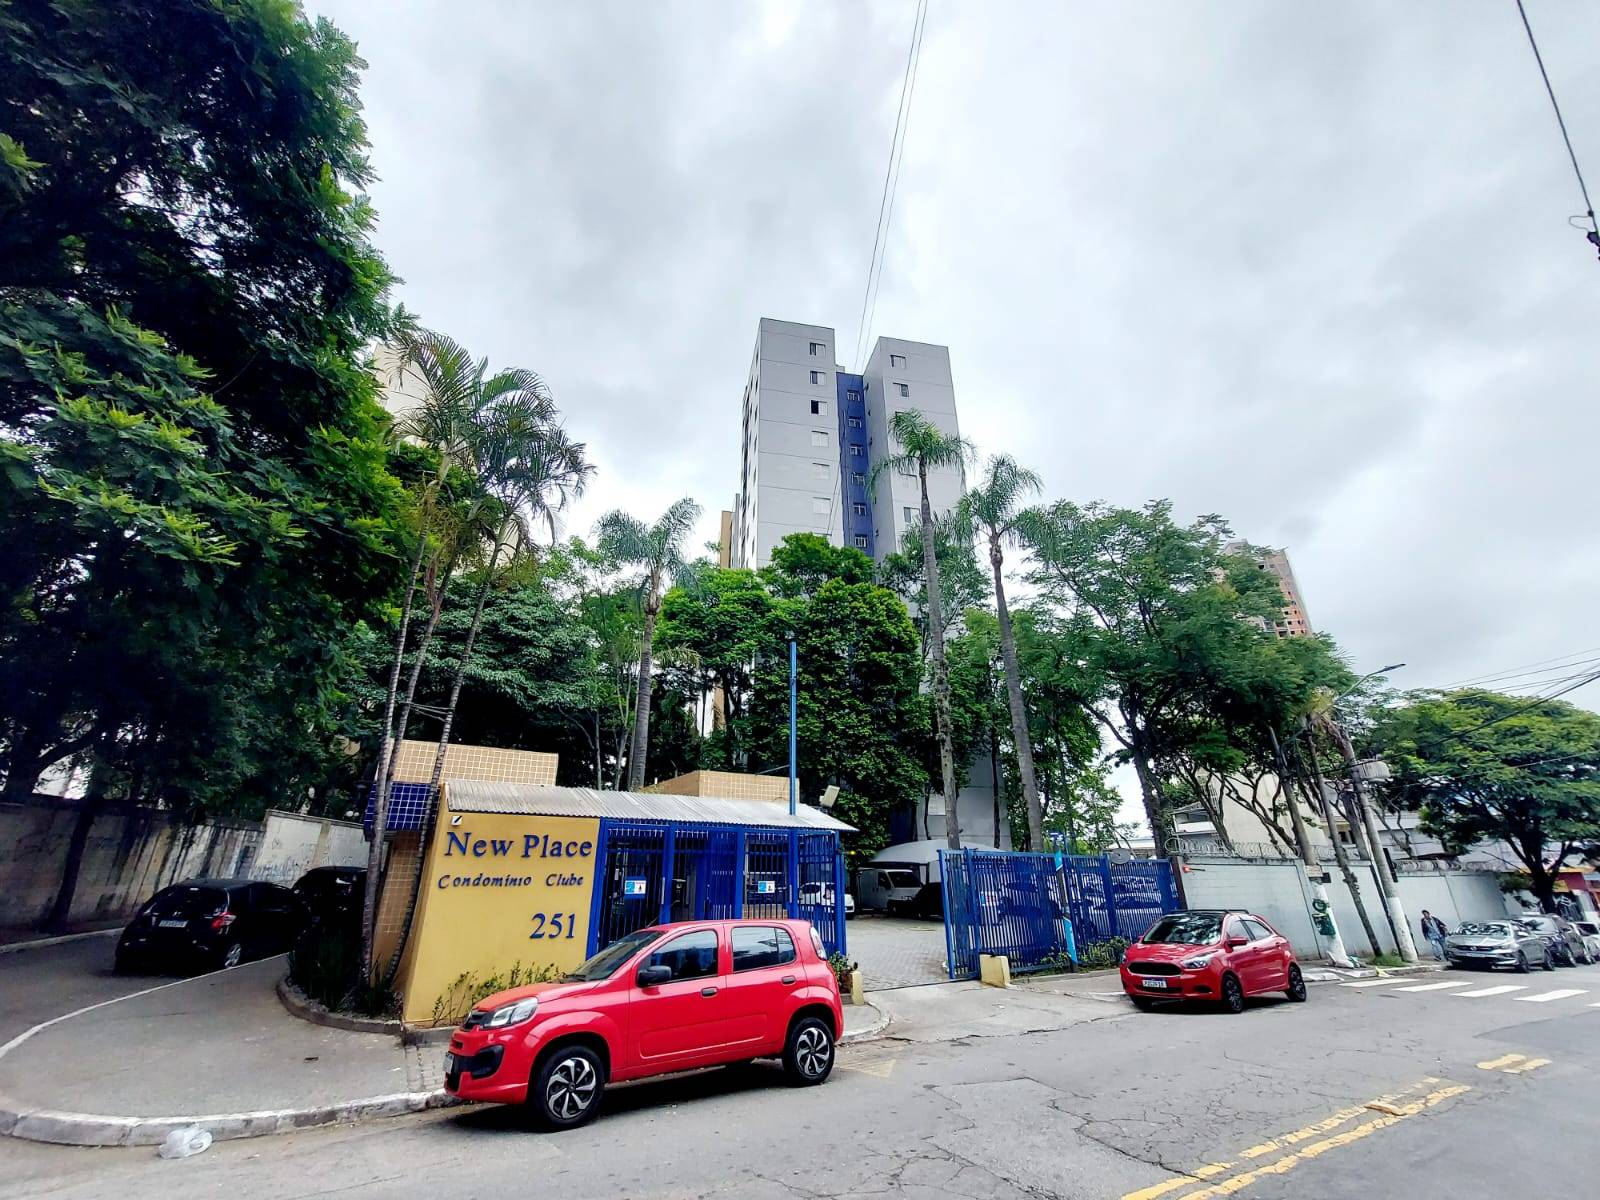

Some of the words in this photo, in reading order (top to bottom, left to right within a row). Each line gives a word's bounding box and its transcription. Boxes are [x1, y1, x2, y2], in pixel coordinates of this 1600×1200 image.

[444, 831, 514, 857] New
[521, 834, 593, 858] Place
[545, 873, 584, 887] Clube
[529, 912, 575, 939] 251
